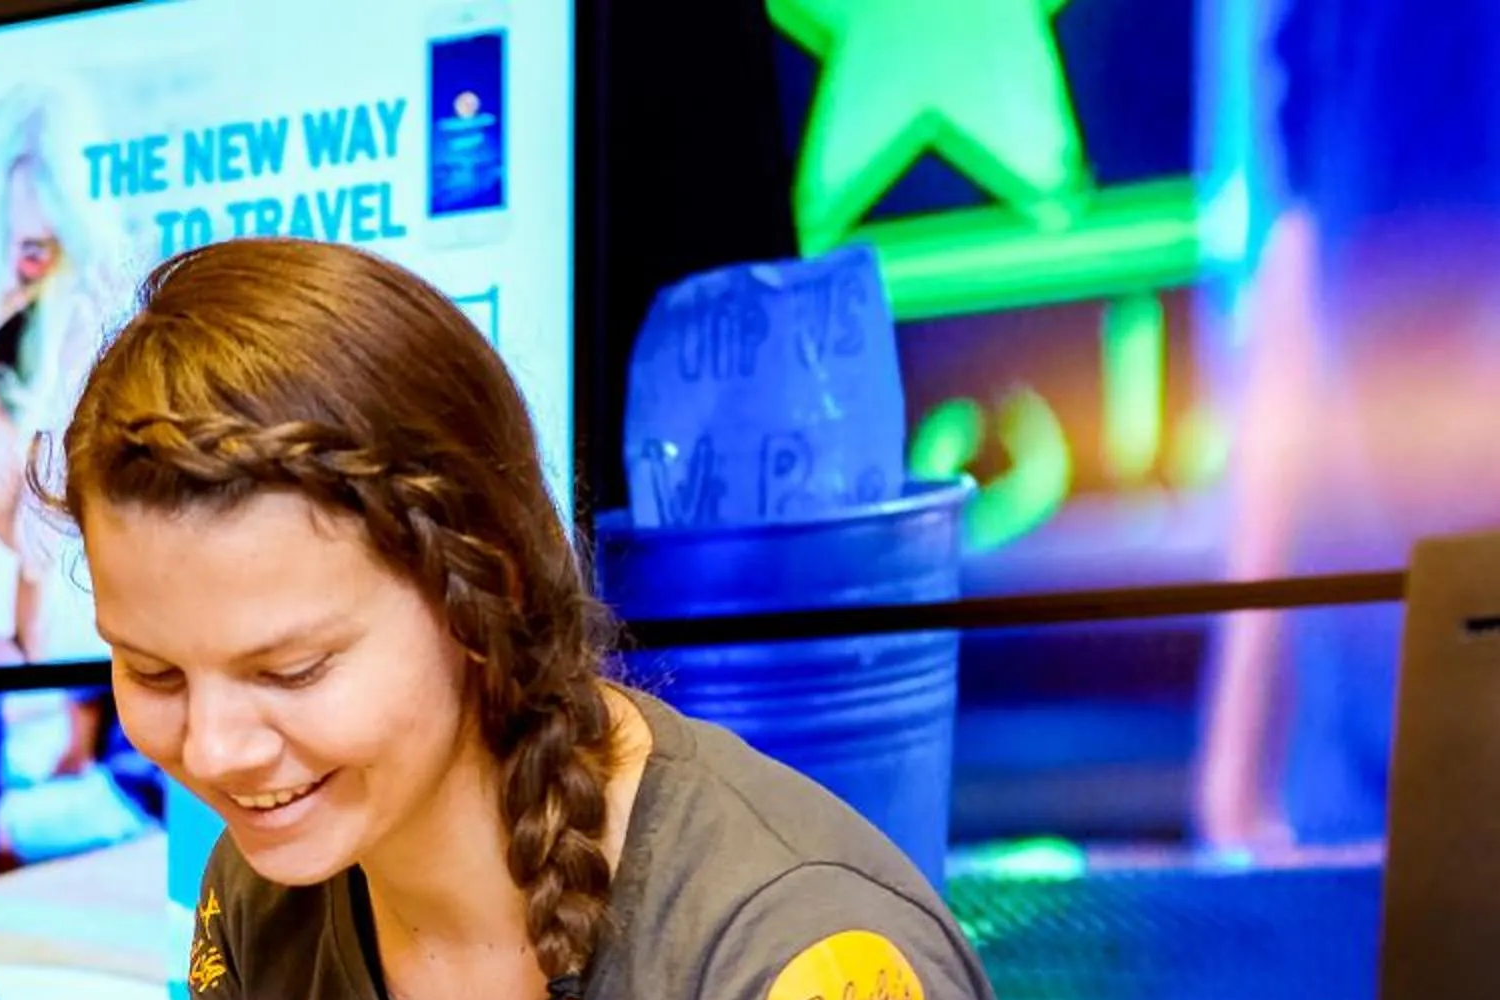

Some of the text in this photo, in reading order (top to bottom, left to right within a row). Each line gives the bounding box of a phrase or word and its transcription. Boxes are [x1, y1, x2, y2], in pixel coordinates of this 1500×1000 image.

[82, 97, 407, 200] THE NEW WAY
[154, 181, 407, 259] TO TRAVEL
